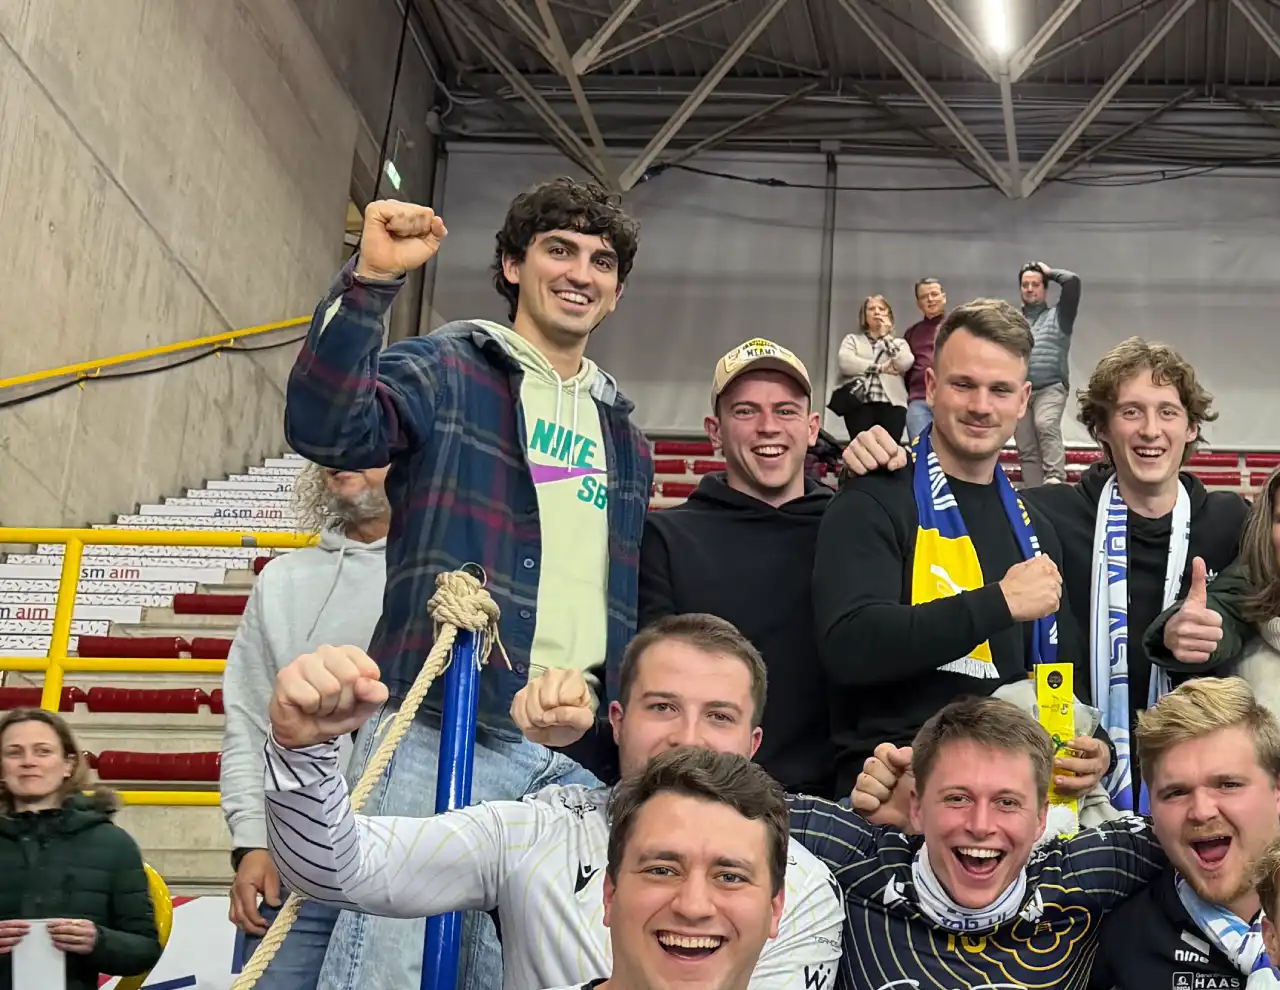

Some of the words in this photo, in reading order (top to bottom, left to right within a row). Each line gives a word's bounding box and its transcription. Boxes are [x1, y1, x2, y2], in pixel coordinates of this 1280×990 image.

[530, 418, 597, 469] NIKE
[577, 475, 607, 510] SB
[256, 509, 283, 519] aim
[109, 566, 140, 579] aim
[16, 608, 49, 620] aim
[1195, 978, 1240, 989] HAAS
